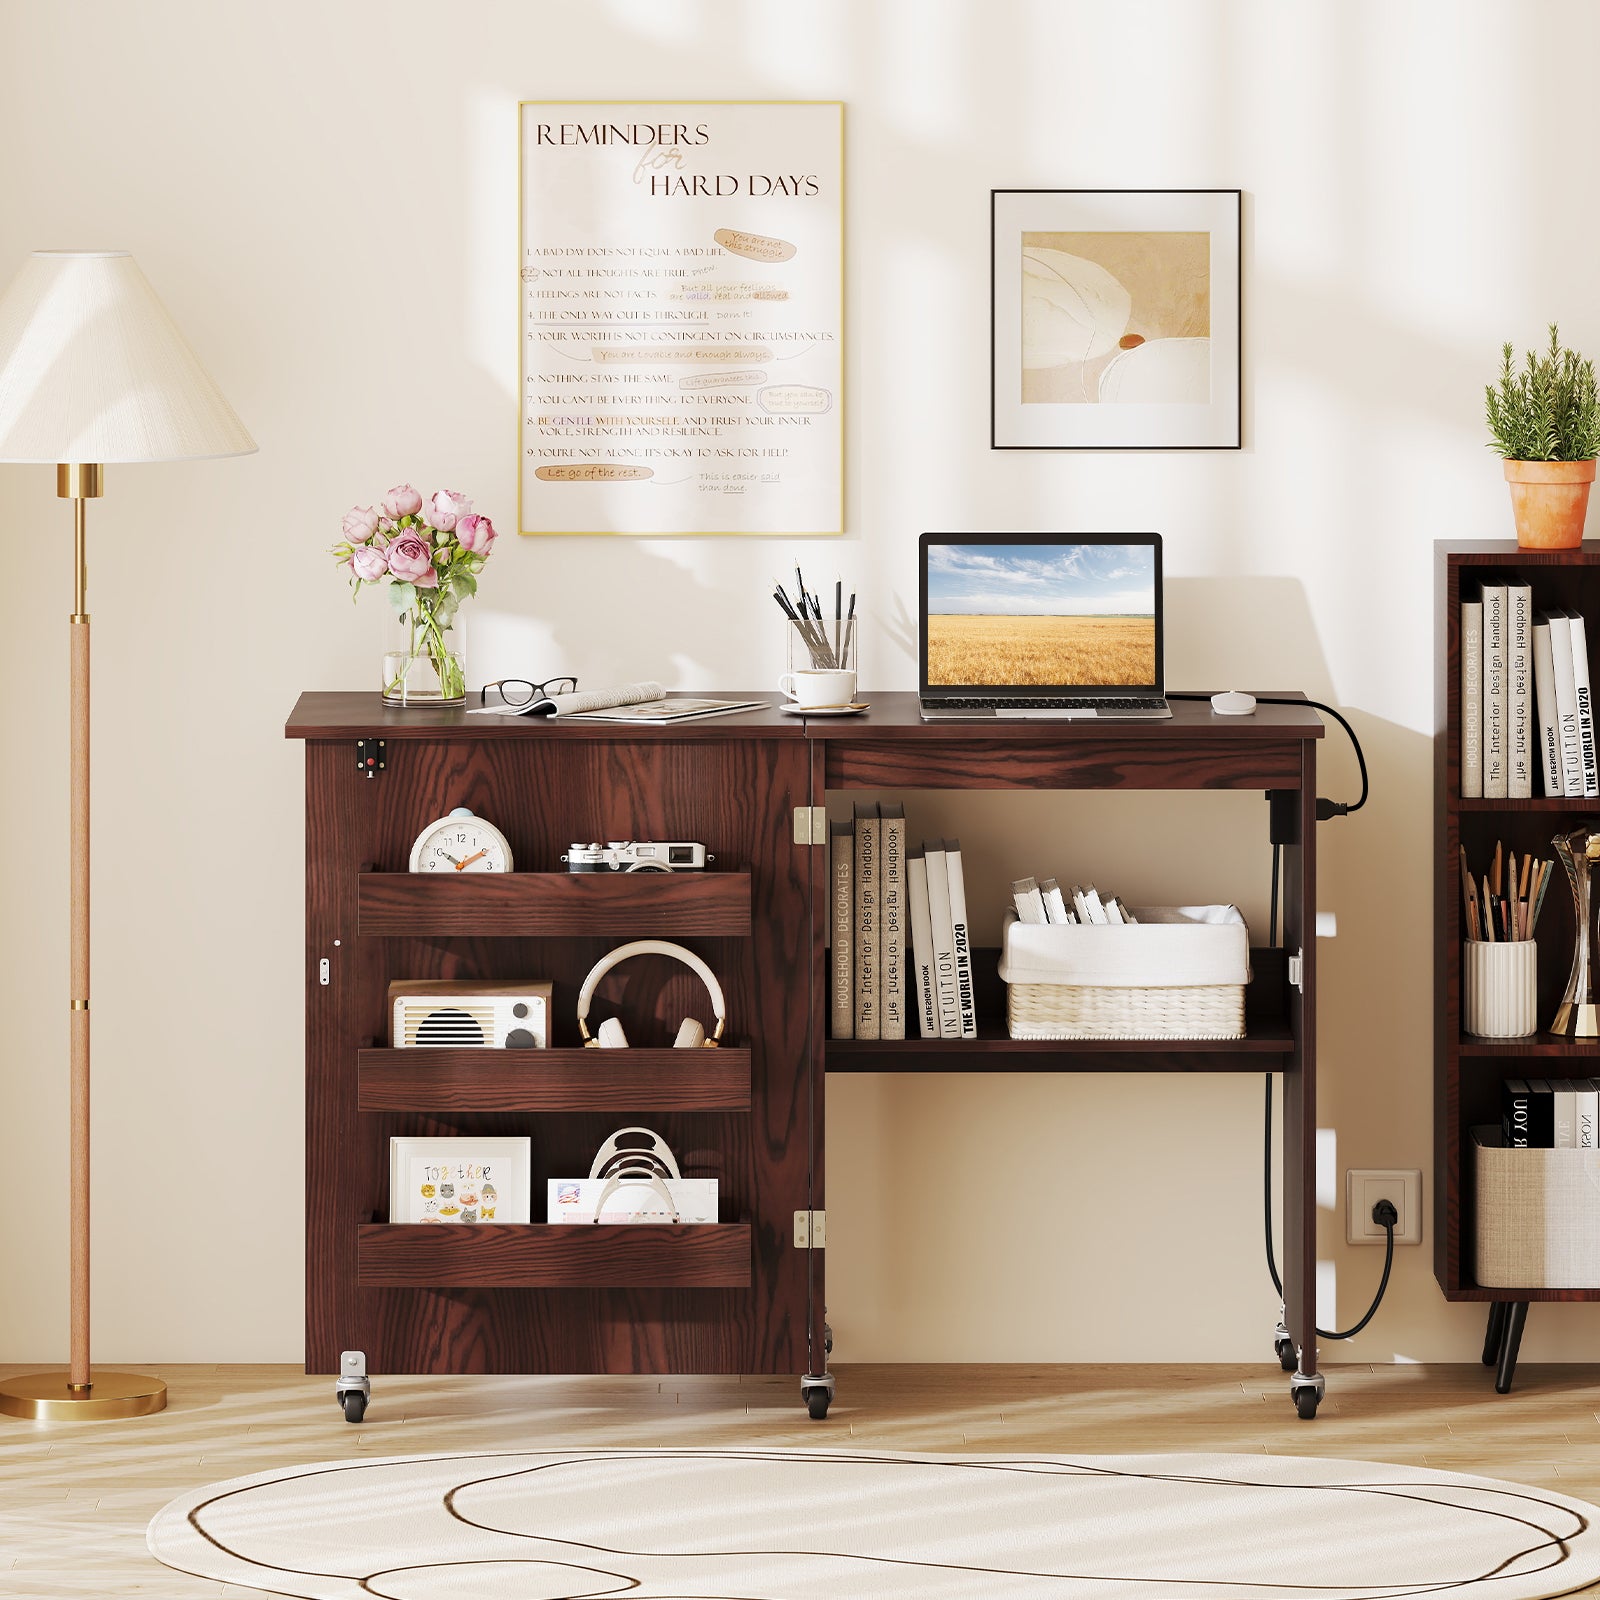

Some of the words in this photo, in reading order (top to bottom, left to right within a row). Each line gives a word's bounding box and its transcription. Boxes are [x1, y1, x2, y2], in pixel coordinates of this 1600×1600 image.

[537, 123, 710, 146] REMINDERS
[633, 142, 687, 184] for
[650, 174, 739, 197] HARD
[749, 174, 820, 197] DAYS
[732, 232, 749, 242] You
[752, 237, 765, 246] are
[766, 240, 781, 249] not
[534, 248, 542, 257] A
[543, 248, 564, 257] BAD
[566, 248, 584, 257] DAY
[587, 248, 613, 257] DOES
[616, 248, 636, 257] NOT
[639, 248, 672, 259] EQUAL
[675, 248, 683, 257] A
[684, 248, 705, 257] BAD
[542, 269, 563, 277] NOT
[566, 269, 584, 277] ALL
[586, 269, 638, 277] THOUGHTS
[641, 269, 660, 277] ARE
[537, 290, 581, 299] FEELINGS
[583, 290, 600, 299] ARE
[603, 290, 623, 299] NOT
[538, 311, 558, 320] THE
[560, 311, 588, 320] ONLY
[590, 311, 613, 320] WAY
[616, 311, 639, 320] OUT
[642, 311, 652, 320] IS
[538, 332, 567, 341] YOUR
[570, 332, 611, 341] WORTH
[613, 332, 622, 341] IS
[625, 332, 647, 341] NOT
[650, 332, 721, 341] CONTINGENT
[724, 332, 743, 341] ON
[600, 351, 617, 361] You
[538, 374, 588, 383] NOTHING
[590, 374, 620, 383] STAYS
[623, 374, 643, 383] THE
[538, 395, 560, 404] YOU
[597, 395, 610, 404] BE
[612, 395, 677, 404] EVERYTHING
[681, 395, 695, 404] TO
[538, 416, 550, 425] BE
[552, 416, 593, 425] GENTLE
[595, 416, 624, 425] WITH
[683, 416, 707, 425] AND
[711, 416, 742, 425] TRUST
[745, 416, 774, 425] YOUR
[778, 416, 812, 425] INNER
[575, 427, 633, 436] STRENGTH
[636, 427, 660, 436] AND
[579, 448, 601, 457] NOT
[663, 448, 693, 457] OKAY
[697, 448, 711, 457] TO
[714, 448, 735, 457] ASK
[737, 448, 759, 457] FOR
[548, 469, 565, 478] Let
[568, 471, 582, 480] go
[584, 466, 598, 480] of
[598, 468, 615, 478] the
[618, 469, 642, 478] rest.
[699, 472, 720, 481] This
[721, 473, 730, 481] is
[732, 473, 758, 481] easier
[760, 472, 781, 481] said
[699, 483, 721, 492] than
[1490, 595, 1500, 649] Handbook
[1467, 630, 1478, 696] DECORATES
[1490, 654, 1503, 695] Design
[1577, 687, 1590, 716] 2020
[1490, 701, 1500, 754] Interior
[1581, 717, 1592, 729] IN
[1467, 701, 1478, 769] HOUSEHOLD
[1563, 713, 1581, 791] INTUITION
[1582, 731, 1595, 770] WORLD
[1490, 760, 1500, 781] The
[1586, 772, 1597, 792] THE
[444, 837, 453, 847] 11
[456, 833, 467, 843] 12
[433, 847, 444, 857] 10
[861, 827, 872, 884] Handbook
[429, 860, 437, 871] 9
[486, 861, 494, 871] 3
[837, 863, 849, 933] DECORATES
[861, 889, 875, 933] Design
[955, 923, 967, 953] 2020
[861, 939, 872, 995] Interior
[957, 956, 969, 968] IN
[837, 938, 849, 1010] HOUSEHOLD
[938, 951, 957, 1034] INTUITION
[958, 970, 972, 1011] WORLD
[861, 1001, 872, 1023] The
[962, 1013, 974, 1034] THE
